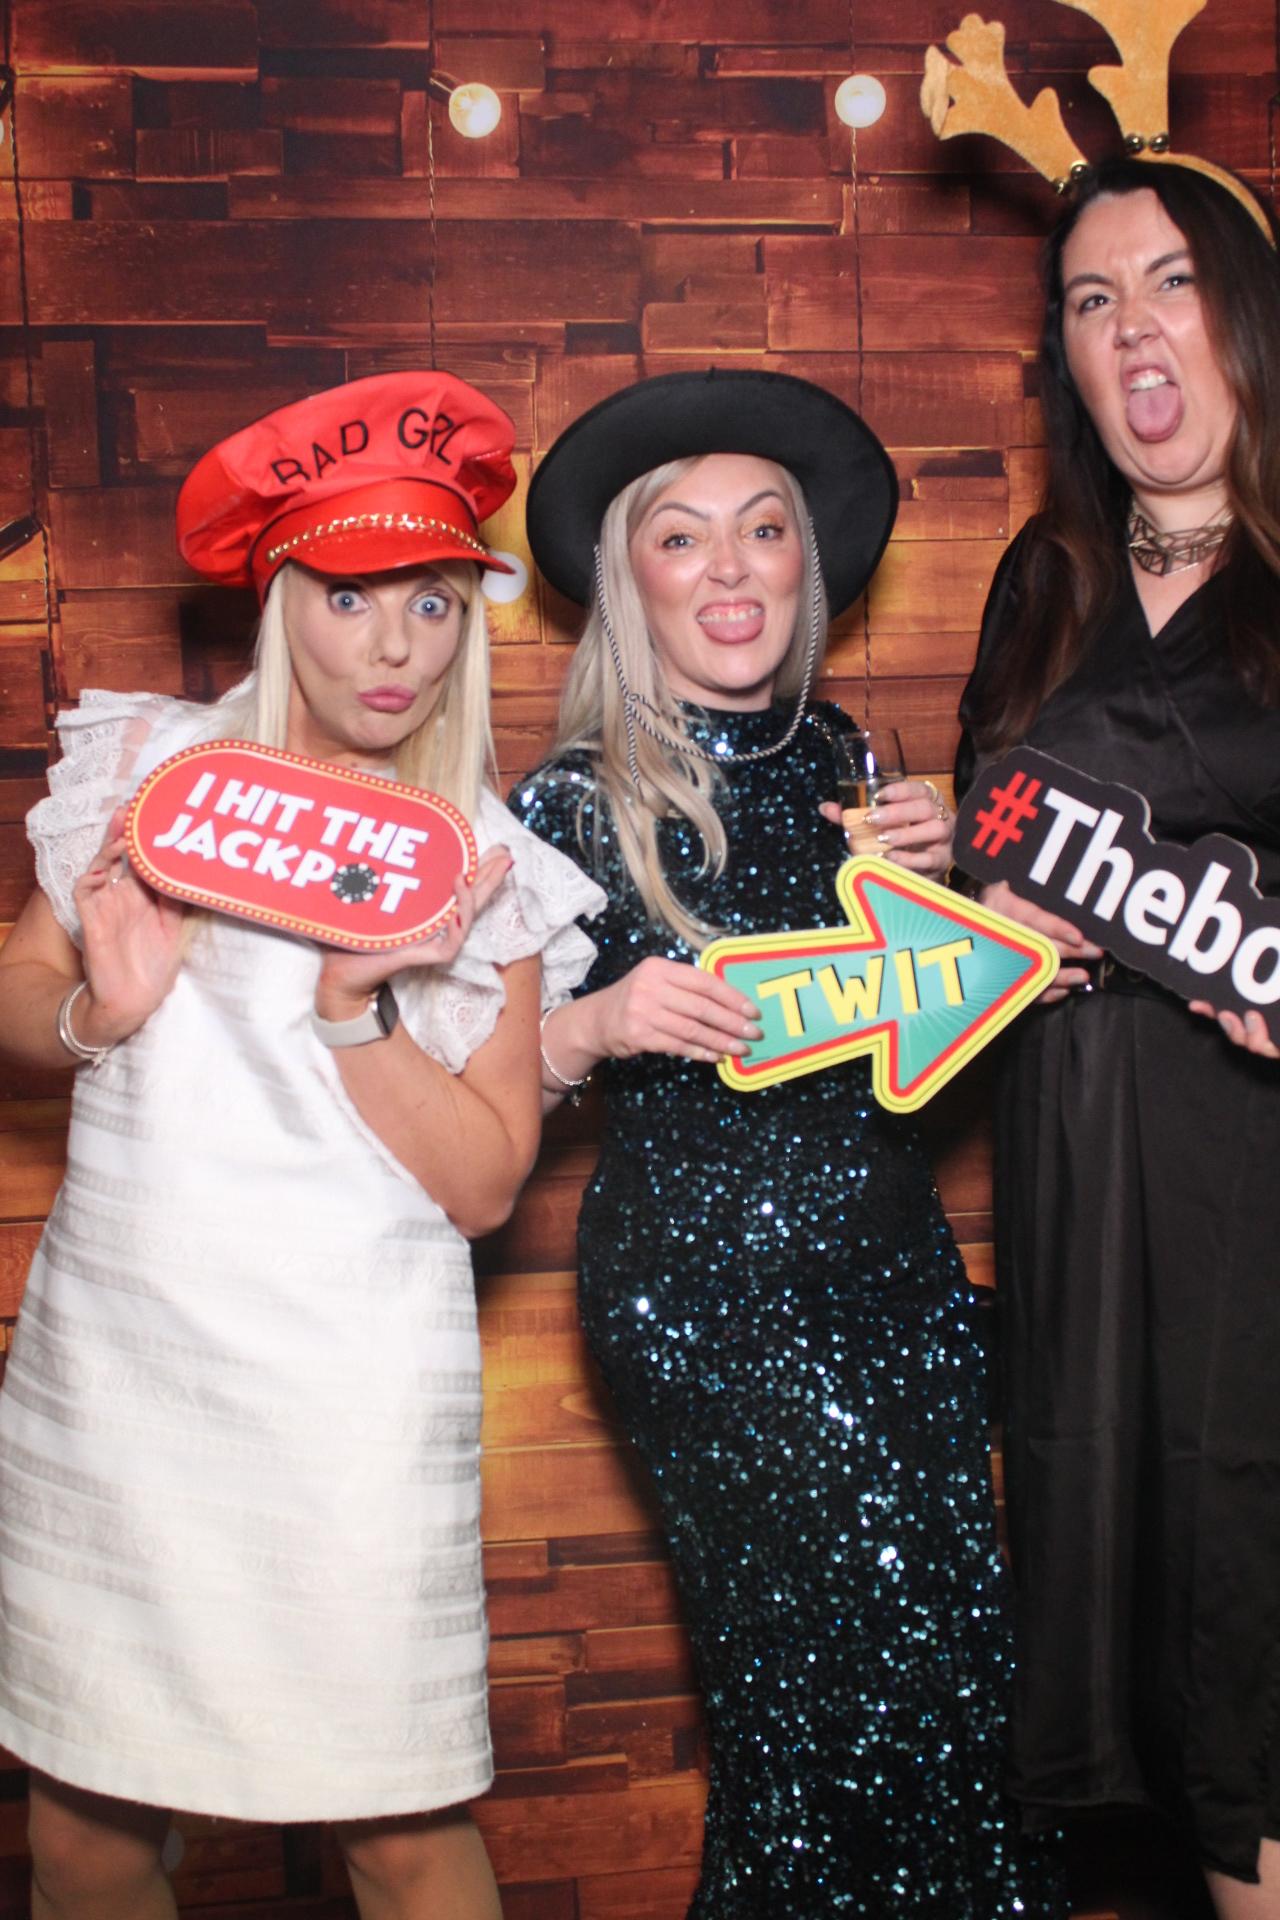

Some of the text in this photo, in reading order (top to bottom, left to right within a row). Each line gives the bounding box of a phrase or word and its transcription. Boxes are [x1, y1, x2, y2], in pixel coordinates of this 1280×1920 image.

[185, 772, 429, 869] I HIT THE
[756, 937, 974, 1037] TWIT
